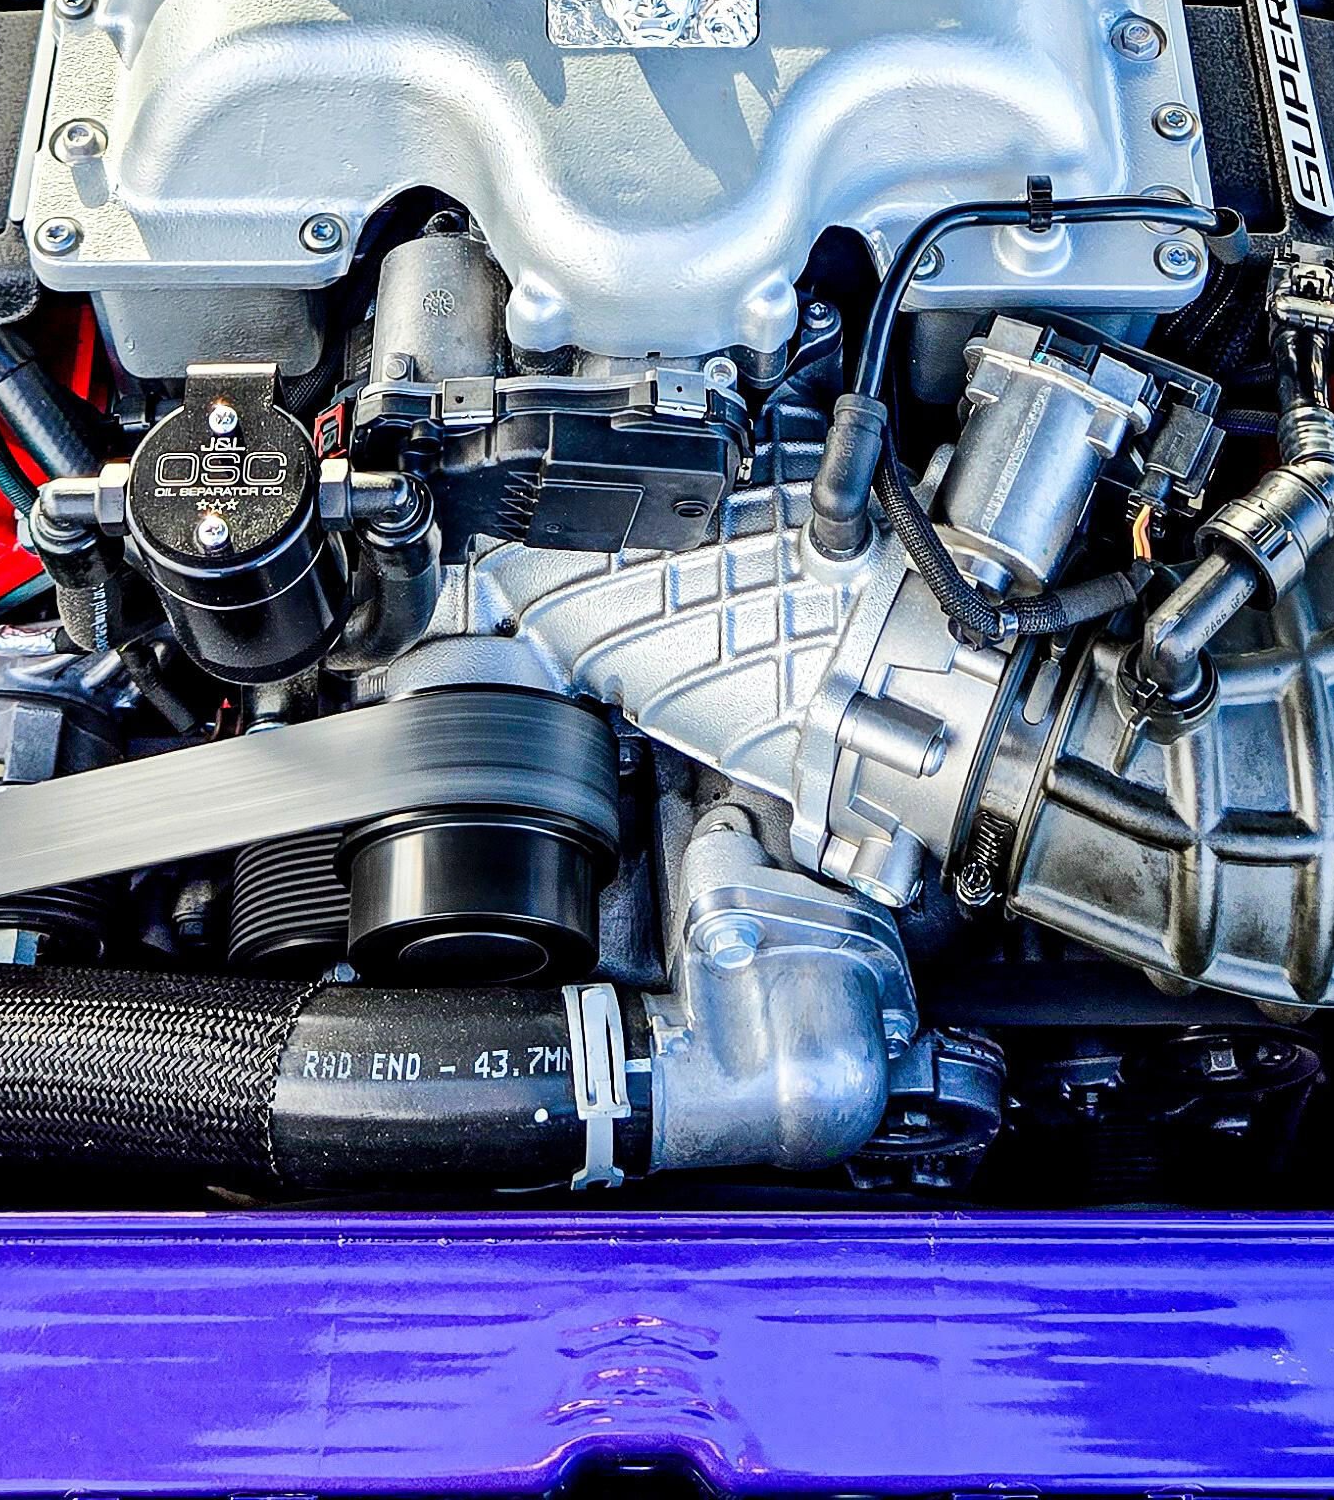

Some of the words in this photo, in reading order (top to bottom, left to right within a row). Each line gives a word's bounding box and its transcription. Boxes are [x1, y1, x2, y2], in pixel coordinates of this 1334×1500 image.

[200, 437, 246, 452] J&L
[155, 451, 288, 487] OSC
[154, 487, 177, 497] OIL
[179, 487, 259, 497] SEPARATOR
[261, 486, 283, 497] CO
[303, 1050, 353, 1079] RAD
[371, 1052, 422, 1082] END
